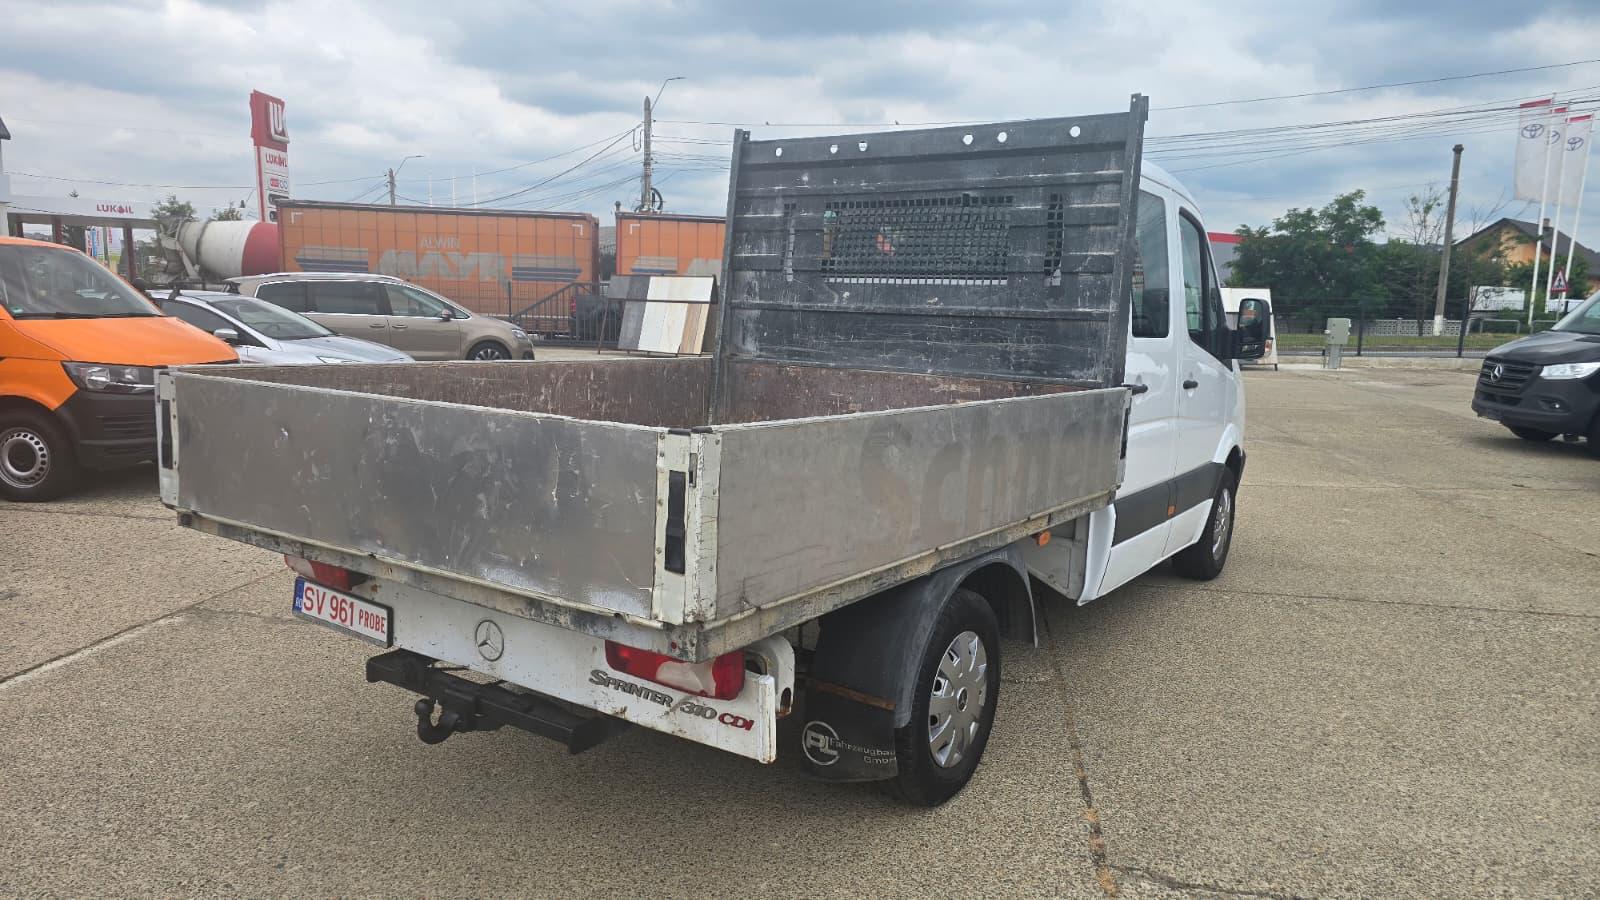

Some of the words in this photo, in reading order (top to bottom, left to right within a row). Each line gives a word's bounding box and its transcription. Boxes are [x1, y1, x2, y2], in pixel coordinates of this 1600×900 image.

[96, 204, 134, 214] LUKOIL
[303, 586, 327, 615] SV
[329, 595, 355, 627] 961
[358, 608, 386, 634] PROBE
[588, 669, 674, 708] SPRINTER
[718, 712, 755, 731] CDI
